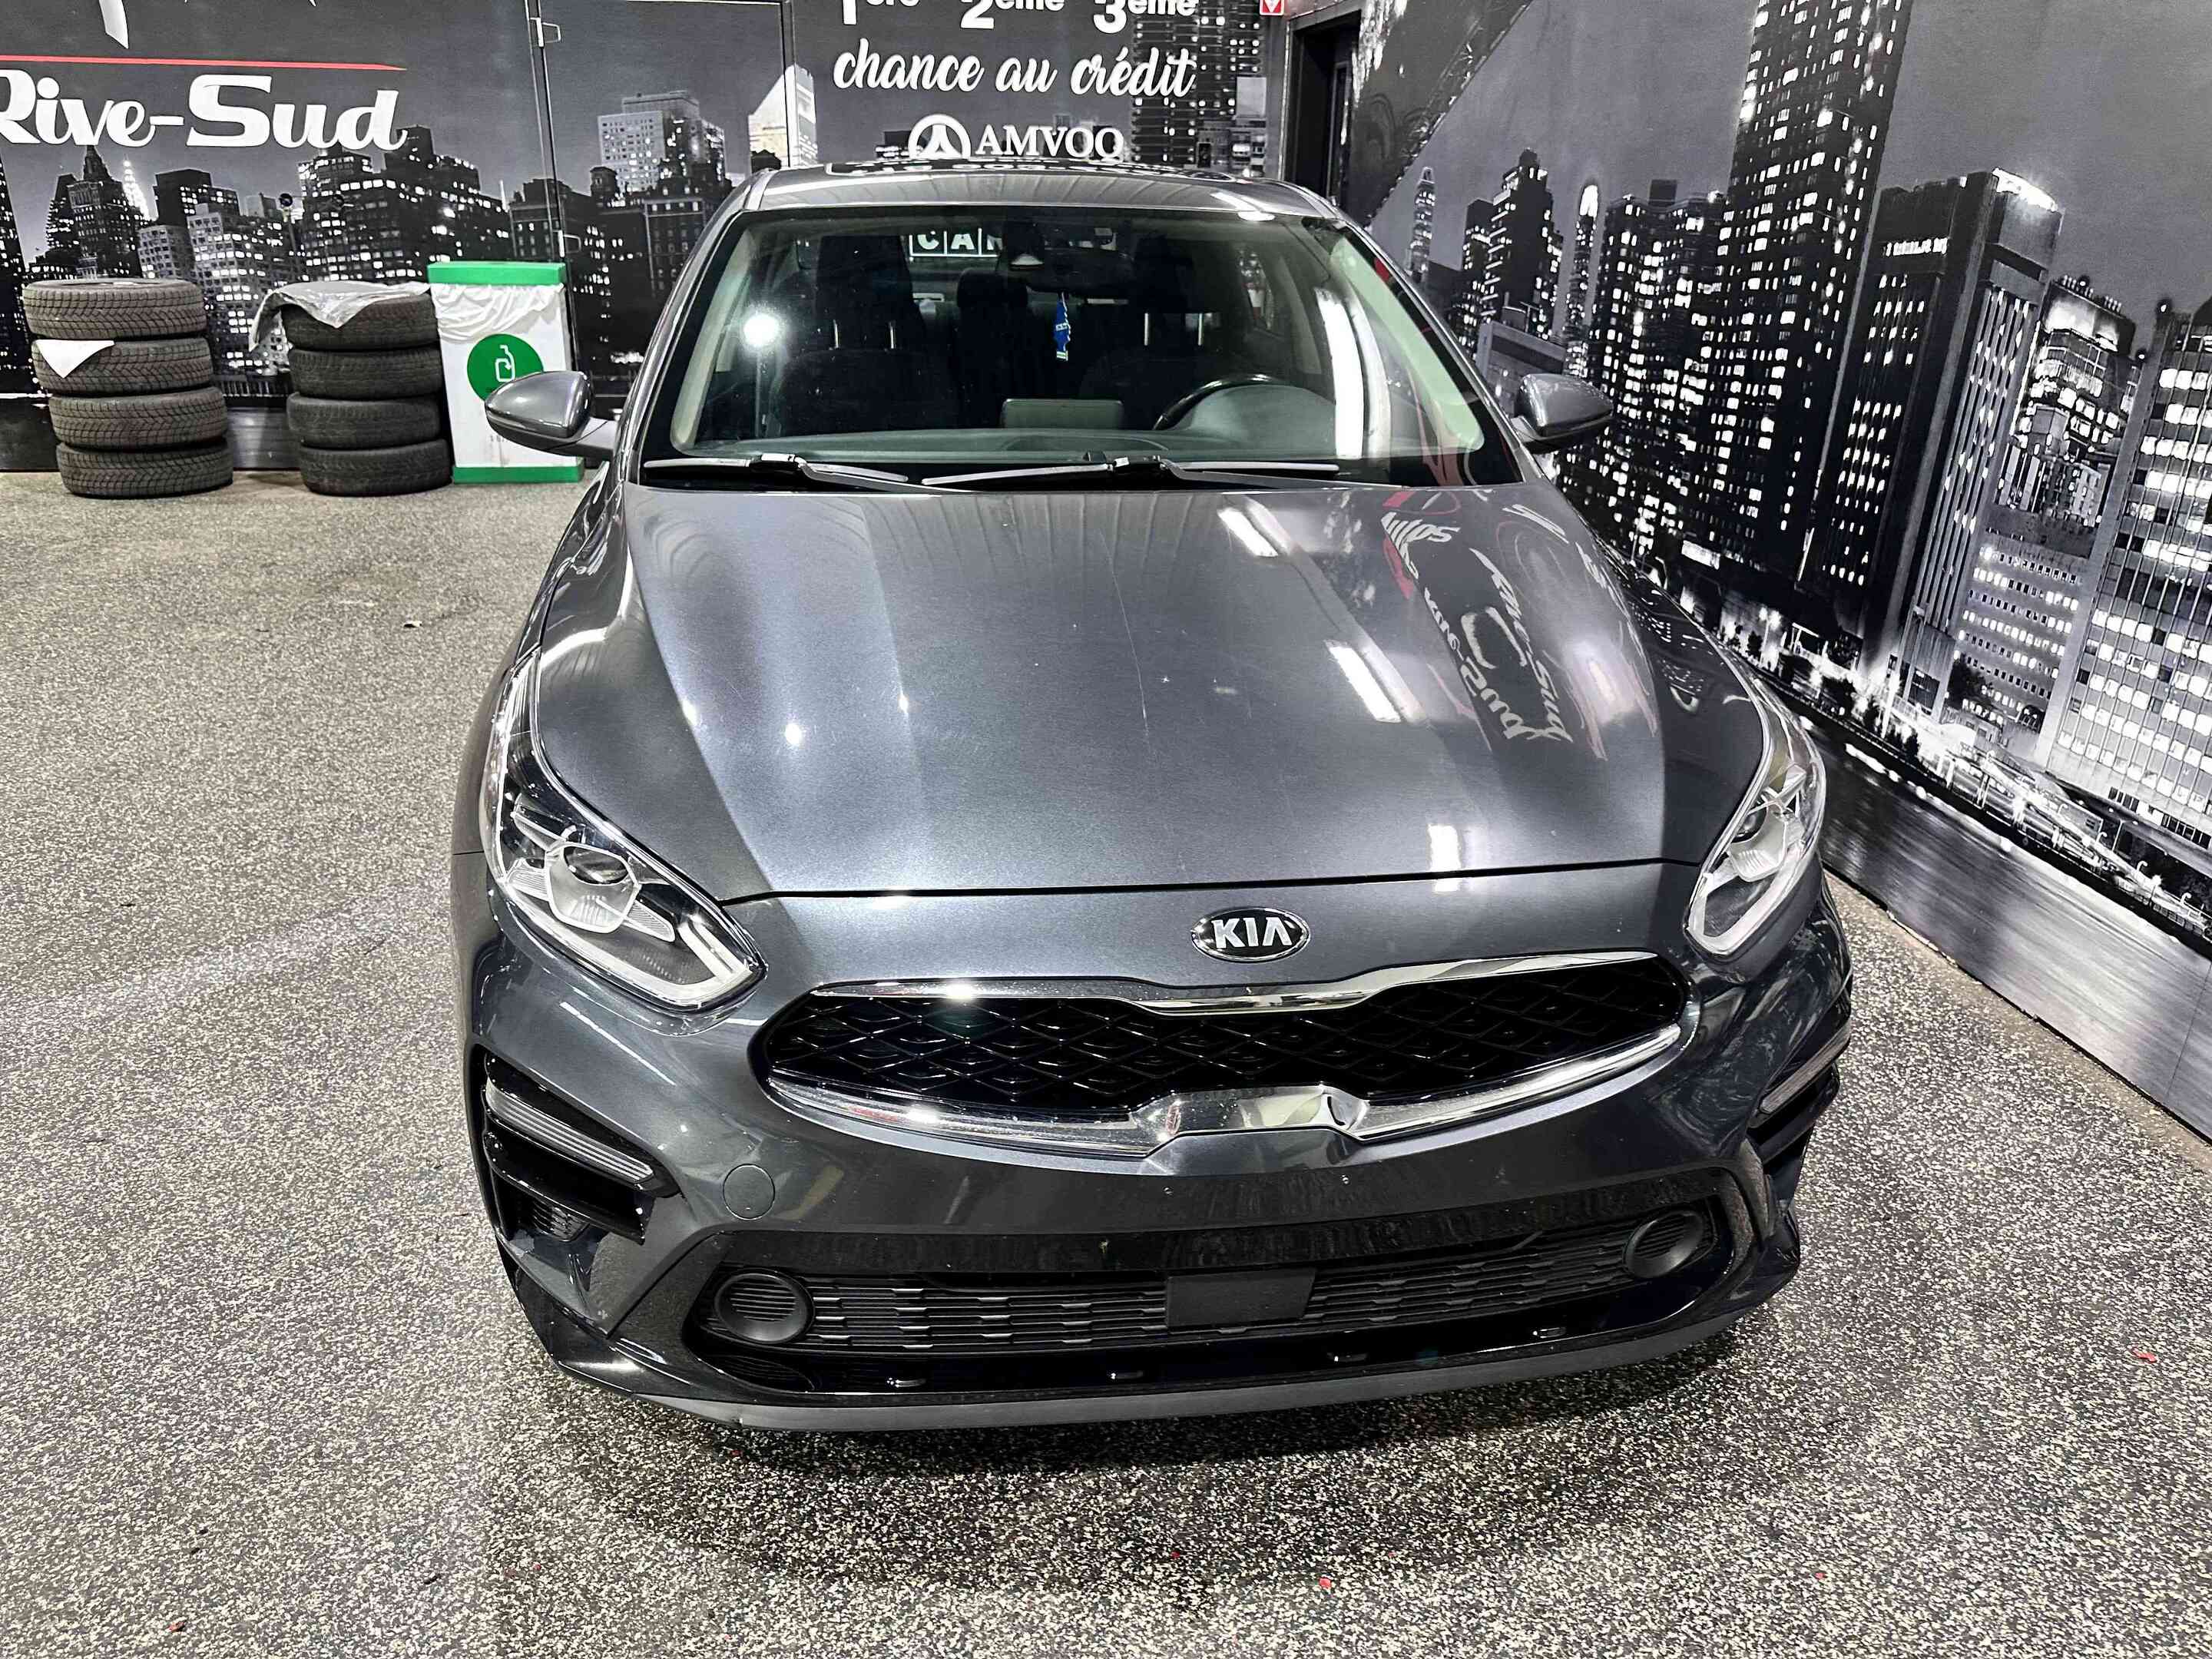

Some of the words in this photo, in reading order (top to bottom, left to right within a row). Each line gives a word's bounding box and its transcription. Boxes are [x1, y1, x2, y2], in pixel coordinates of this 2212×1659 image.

[833, 38, 985, 91] chance
[995, 57, 1058, 93] au
[1071, 46, 1197, 98] crédit
[1211, 916, 1293, 949] KIA
